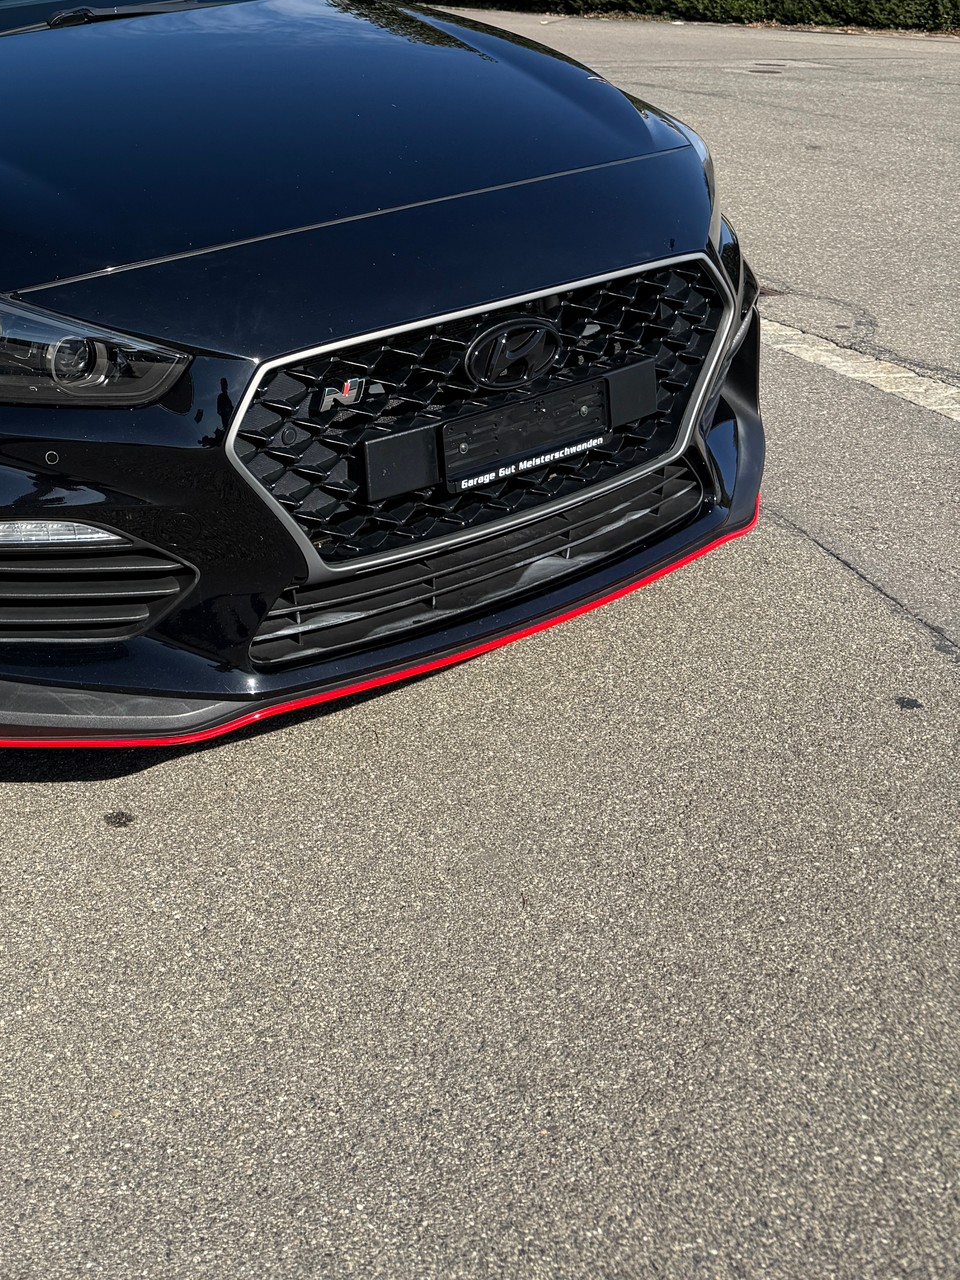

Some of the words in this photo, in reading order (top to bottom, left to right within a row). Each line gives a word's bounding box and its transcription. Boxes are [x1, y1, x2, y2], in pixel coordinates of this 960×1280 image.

[461, 472, 496, 490] Garage
[498, 465, 516, 477] Gut
[519, 437, 604, 471] Meisterschwanden
